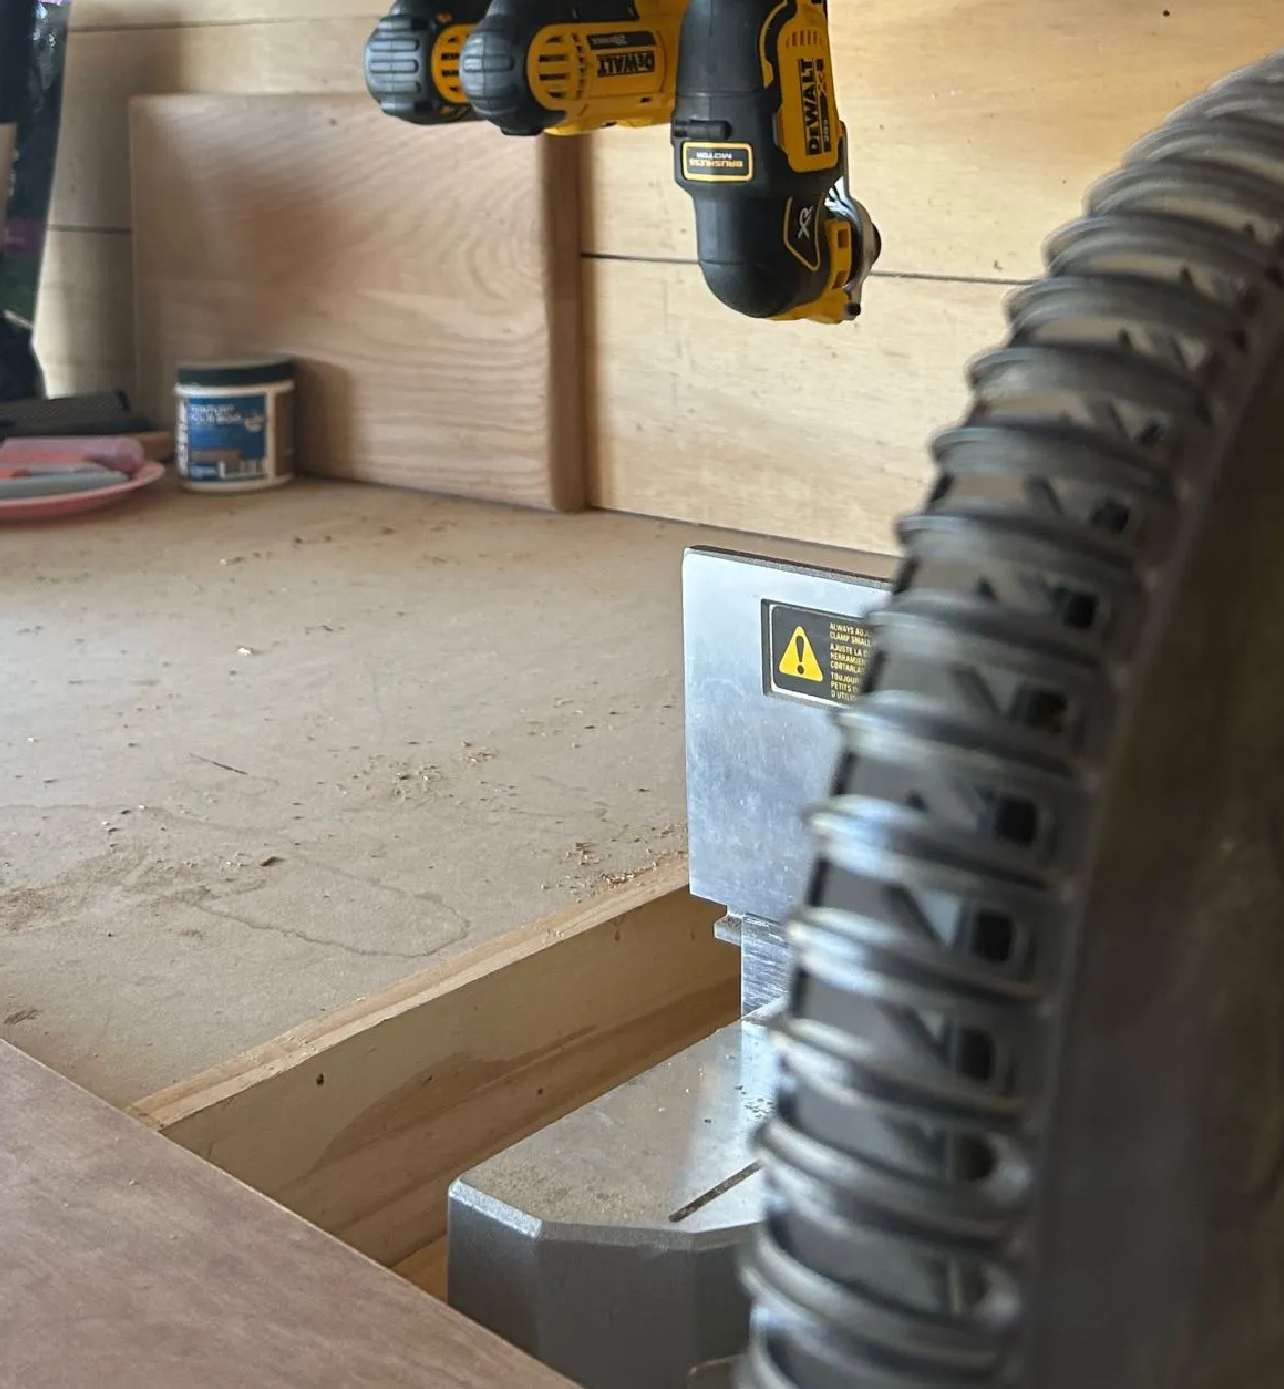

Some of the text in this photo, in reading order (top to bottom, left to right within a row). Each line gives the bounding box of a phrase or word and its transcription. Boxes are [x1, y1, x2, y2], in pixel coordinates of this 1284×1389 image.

[799, 59, 821, 155] DEWALT
[798, 204, 813, 240] XR
[829, 622, 854, 636] ALWAYS
[829, 631, 850, 642] CLAMP
